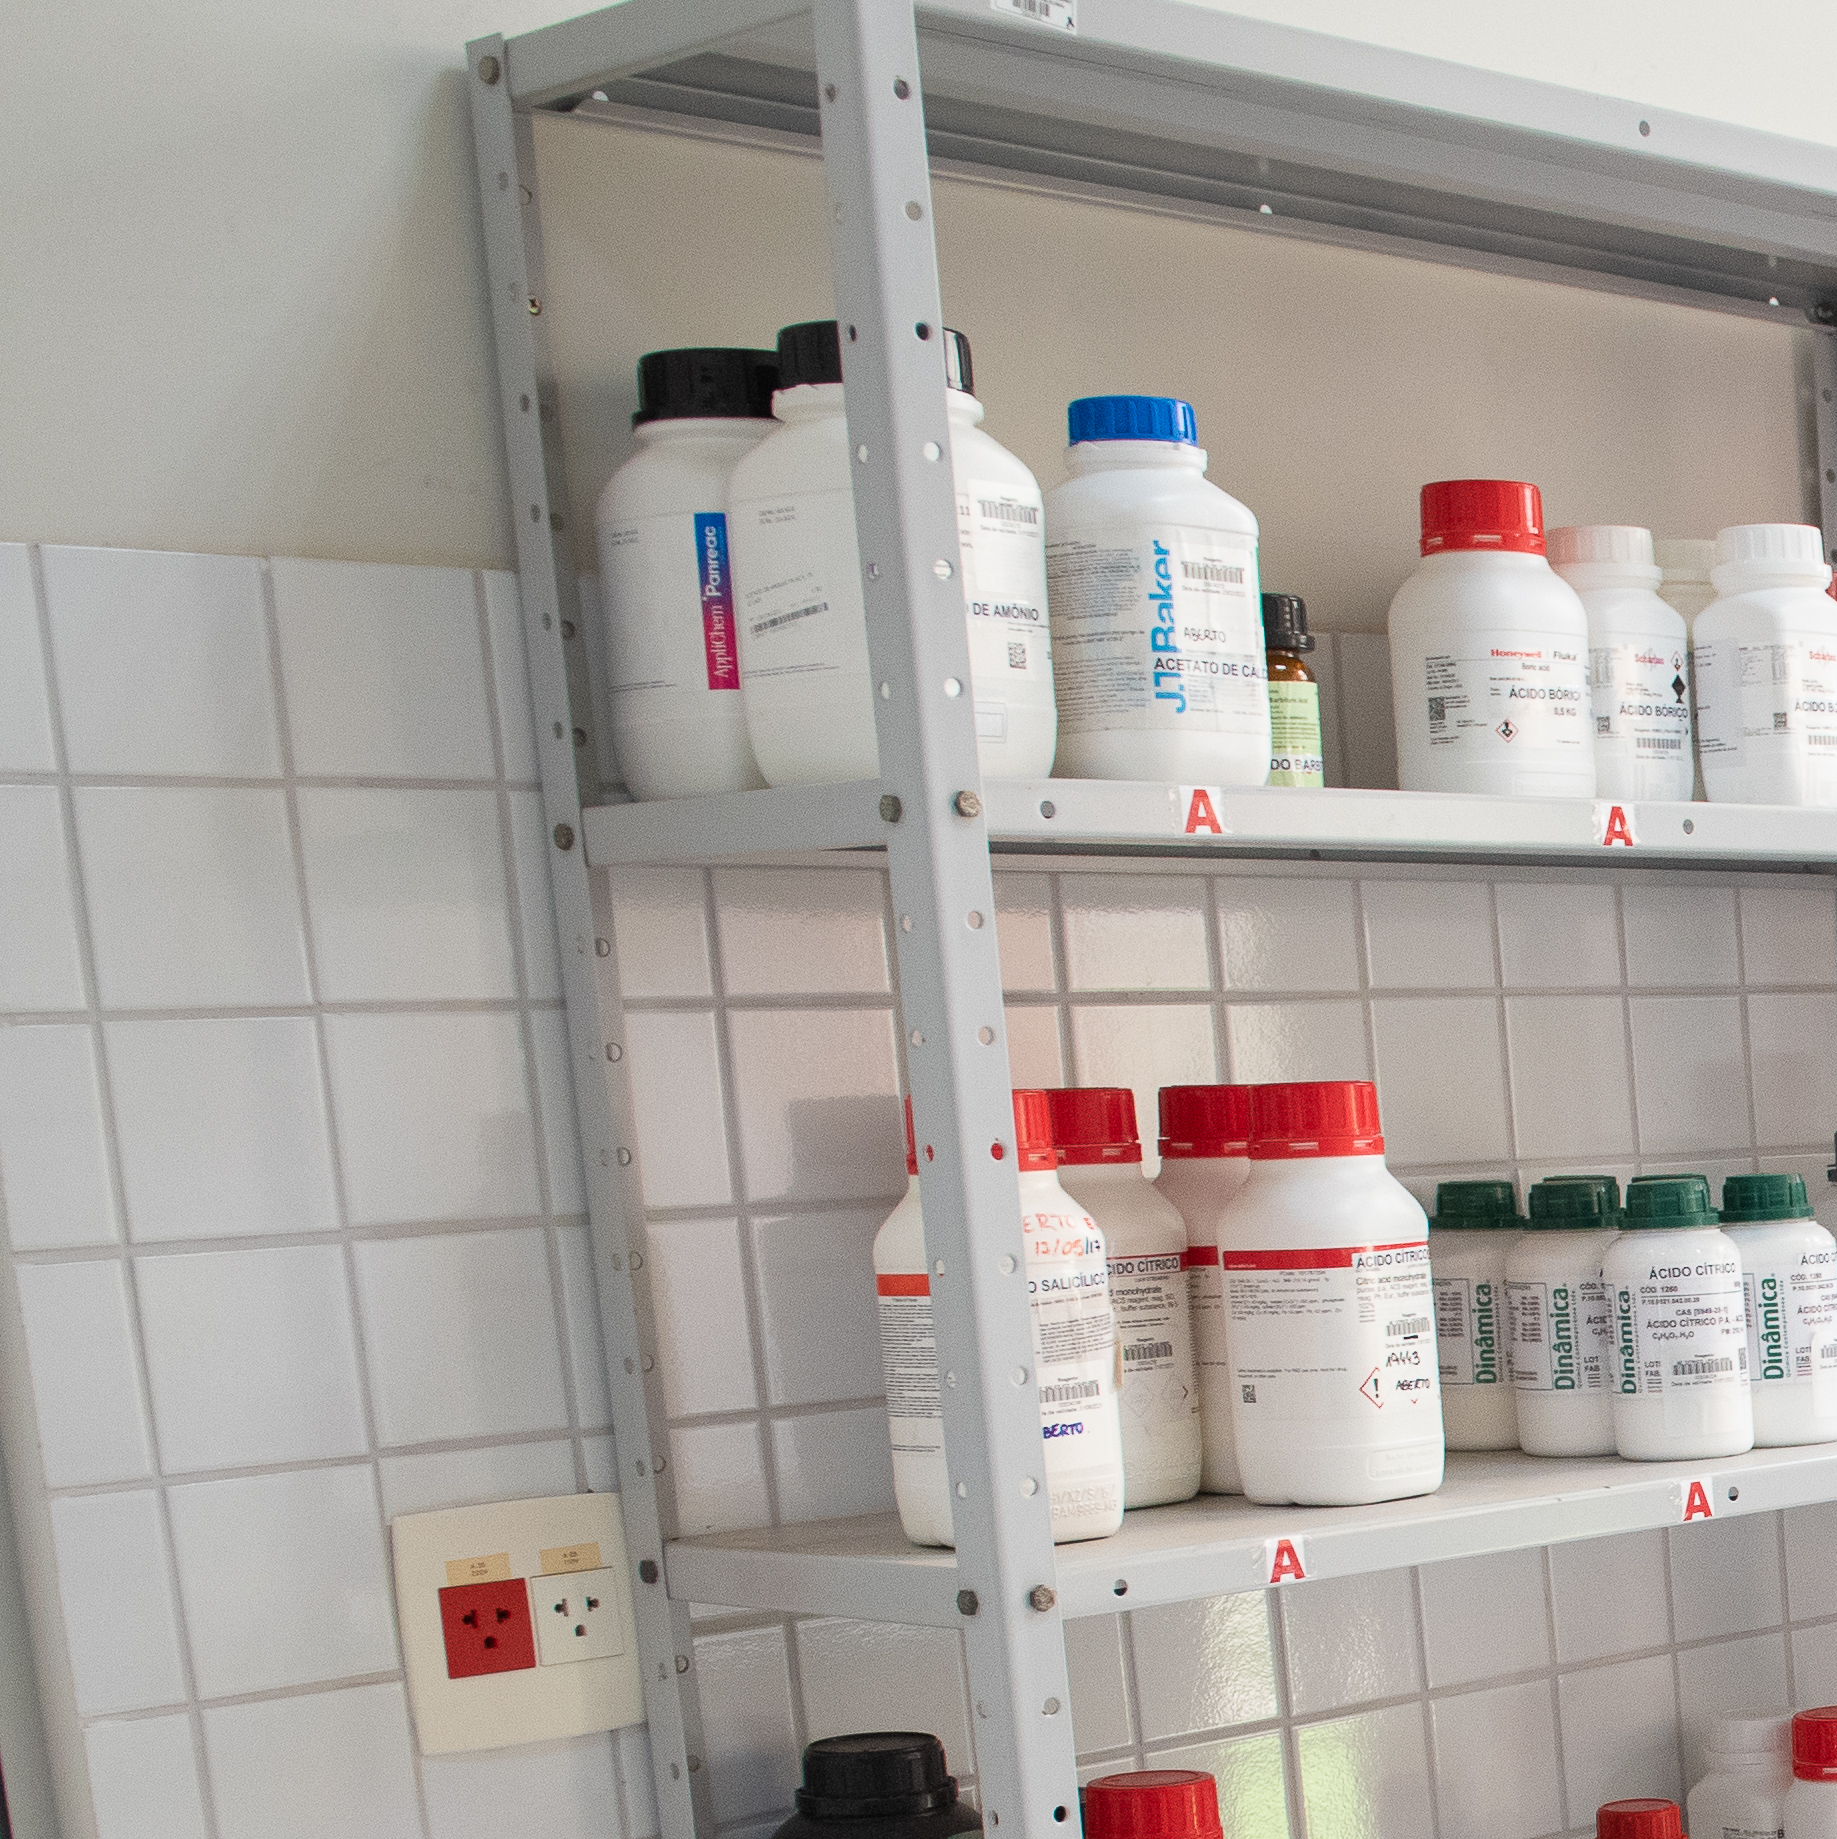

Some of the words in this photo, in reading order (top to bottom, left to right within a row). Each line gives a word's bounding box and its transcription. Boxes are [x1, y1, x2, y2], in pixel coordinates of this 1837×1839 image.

[704, 525, 723, 598] Panreac
[973, 602, 990, 617] DE
[993, 600, 1040, 622] AMÔNIO
[1183, 626, 1227, 644] ABERTO
[1154, 656, 1219, 677] ACETATO
[1222, 661, 1239, 677] DE
[1509, 684, 1546, 701] ÁCIDO
[1619, 705, 1653, 717] ÁCIDO
[1185, 789, 1222, 834] A
[1603, 806, 1633, 847] A
[1138, 1255, 1179, 1274] CÍTRICO
[1356, 1252, 1393, 1268] ÁCIDO
[1649, 1266, 1692, 1280] ÁCIDO
[1695, 1262, 1736, 1277] CÍTRICO
[1476, 1283, 1498, 1385] Dinâmica
[1551, 1288, 1577, 1391] Dinâmica
[1619, 1290, 1638, 1395] Dinâmica
[1760, 1277, 1785, 1380] Dinâmica
[1043, 1421, 1083, 1440] BERTO
[1683, 1481, 1713, 1521] A
[1270, 1539, 1305, 1583] A
